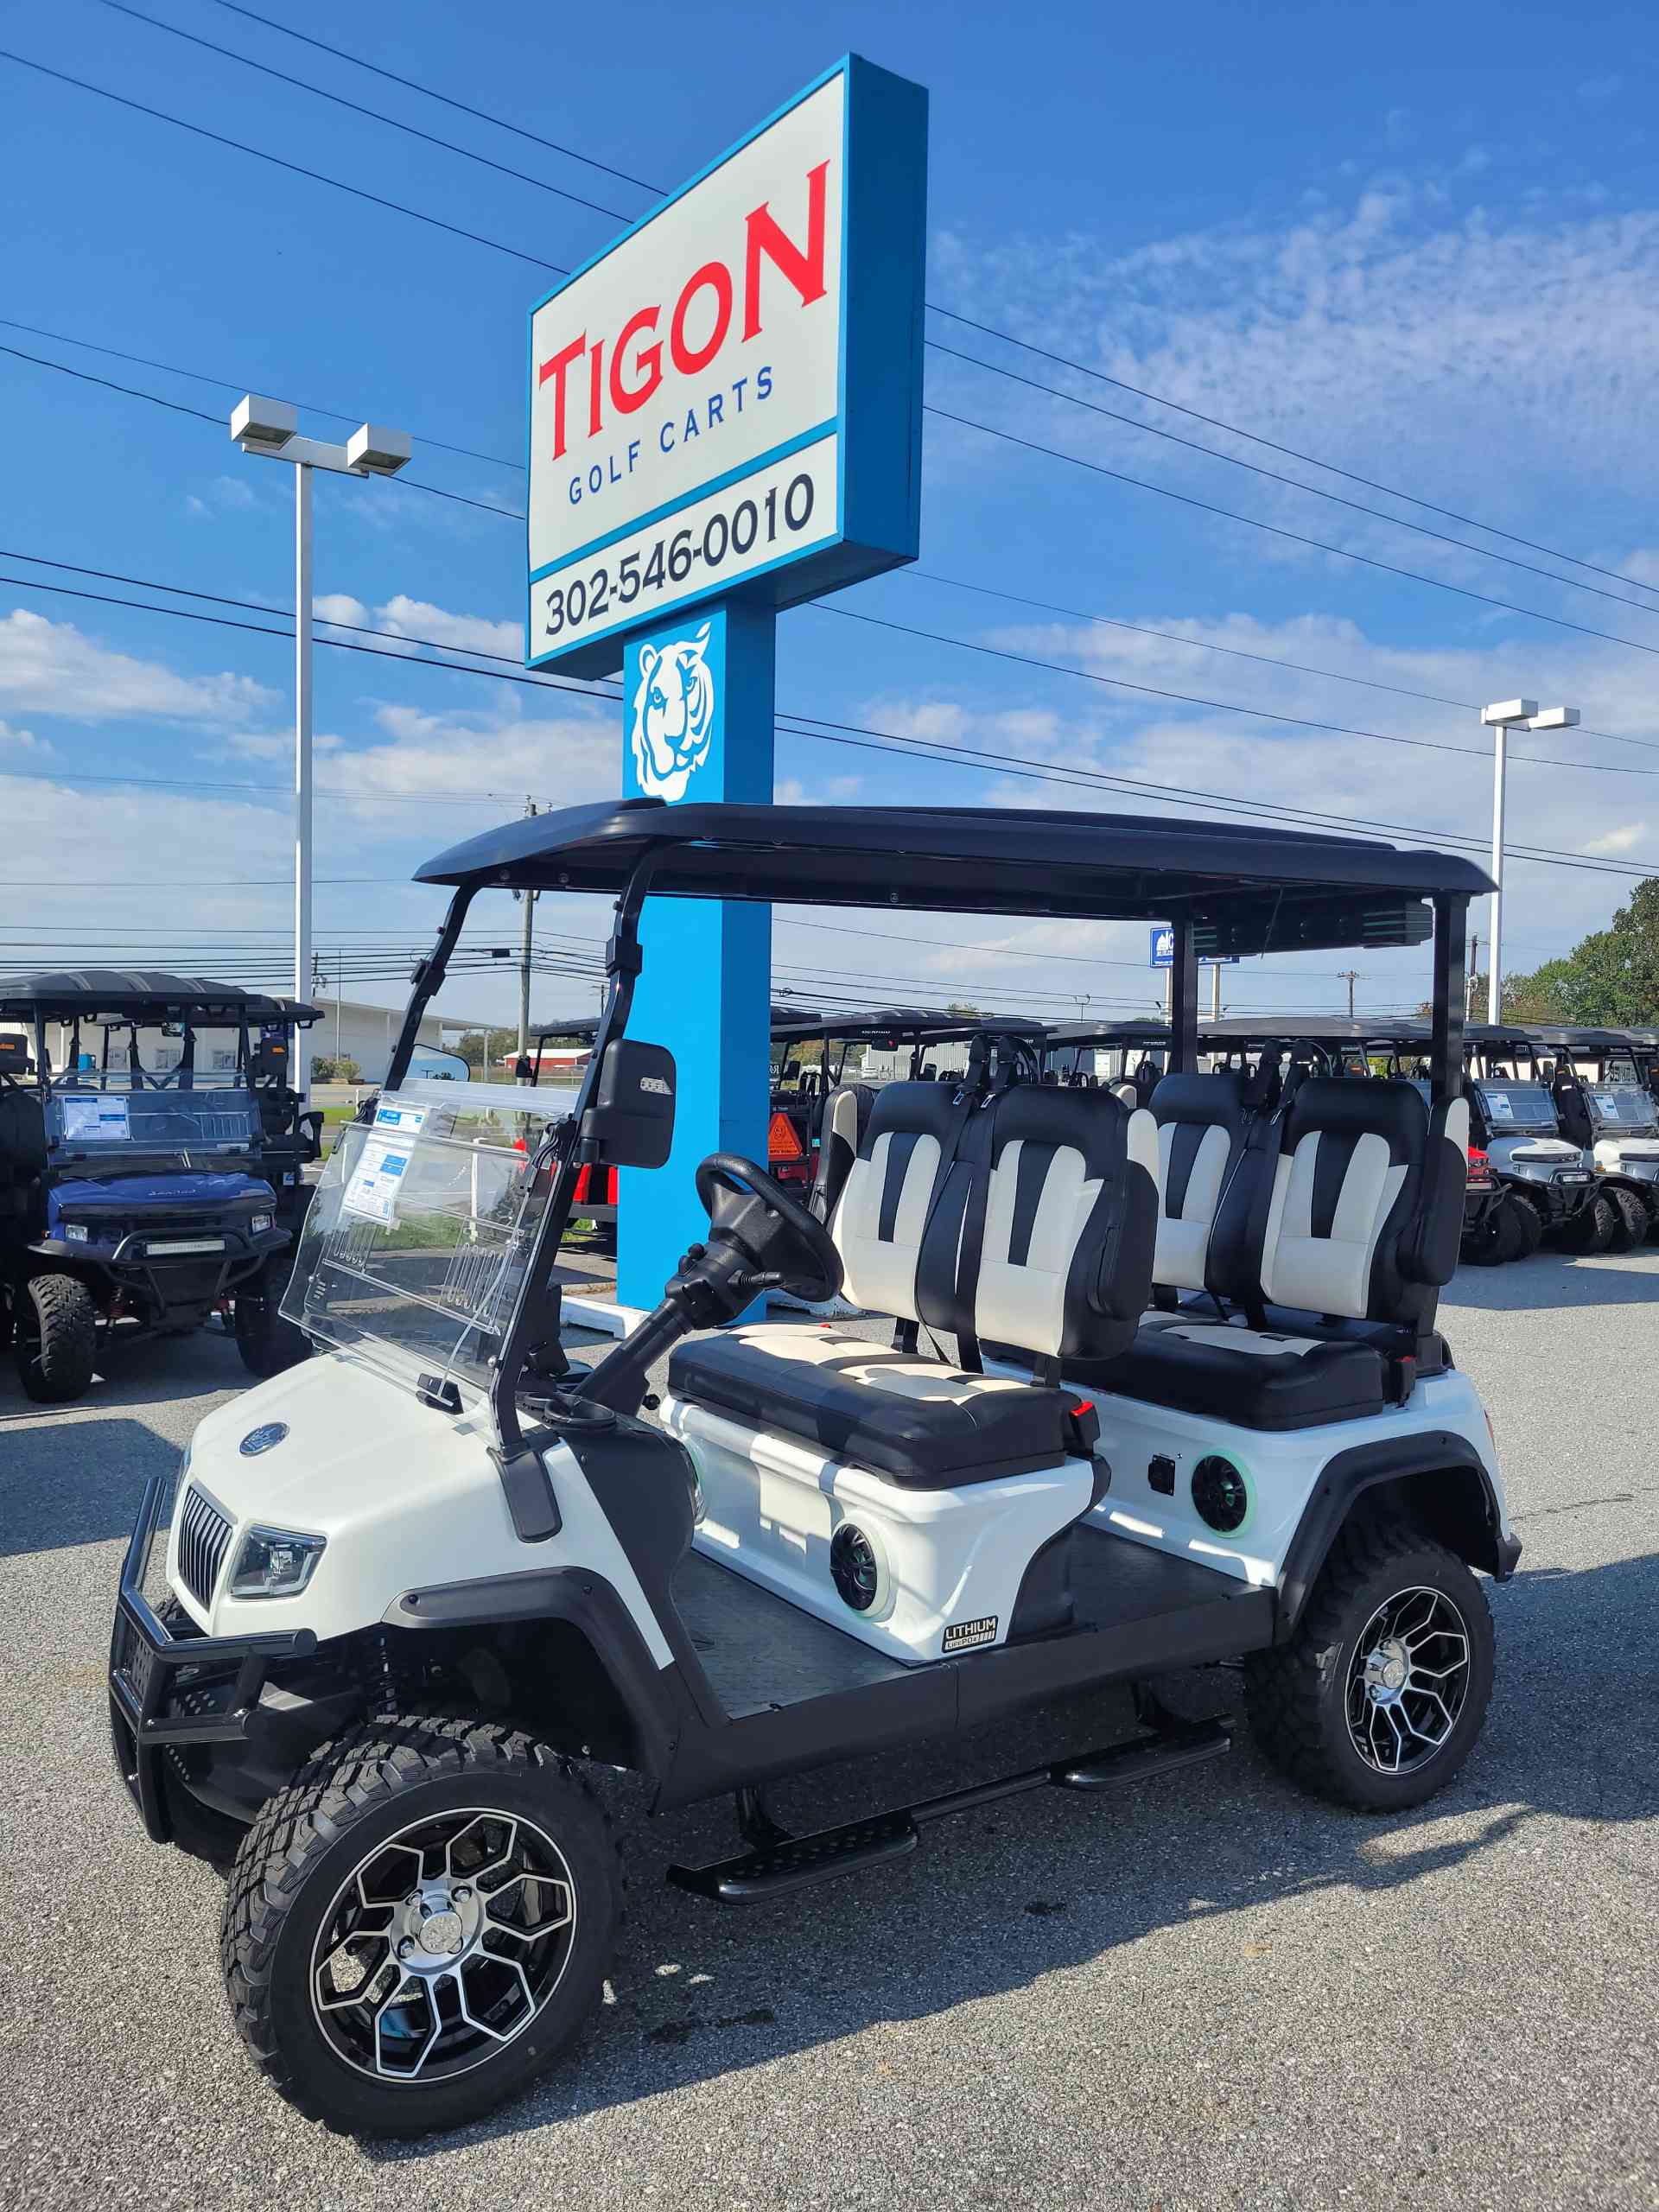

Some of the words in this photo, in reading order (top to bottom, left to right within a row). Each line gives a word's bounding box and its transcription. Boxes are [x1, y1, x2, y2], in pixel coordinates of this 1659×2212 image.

[539, 159, 830, 461] TIGON
[569, 441, 641, 505] GOLF
[659, 365, 772, 452] CARTS
[545, 474, 814, 636] 302-546-0010
[946, 1618, 995, 1639] LITHIUM
